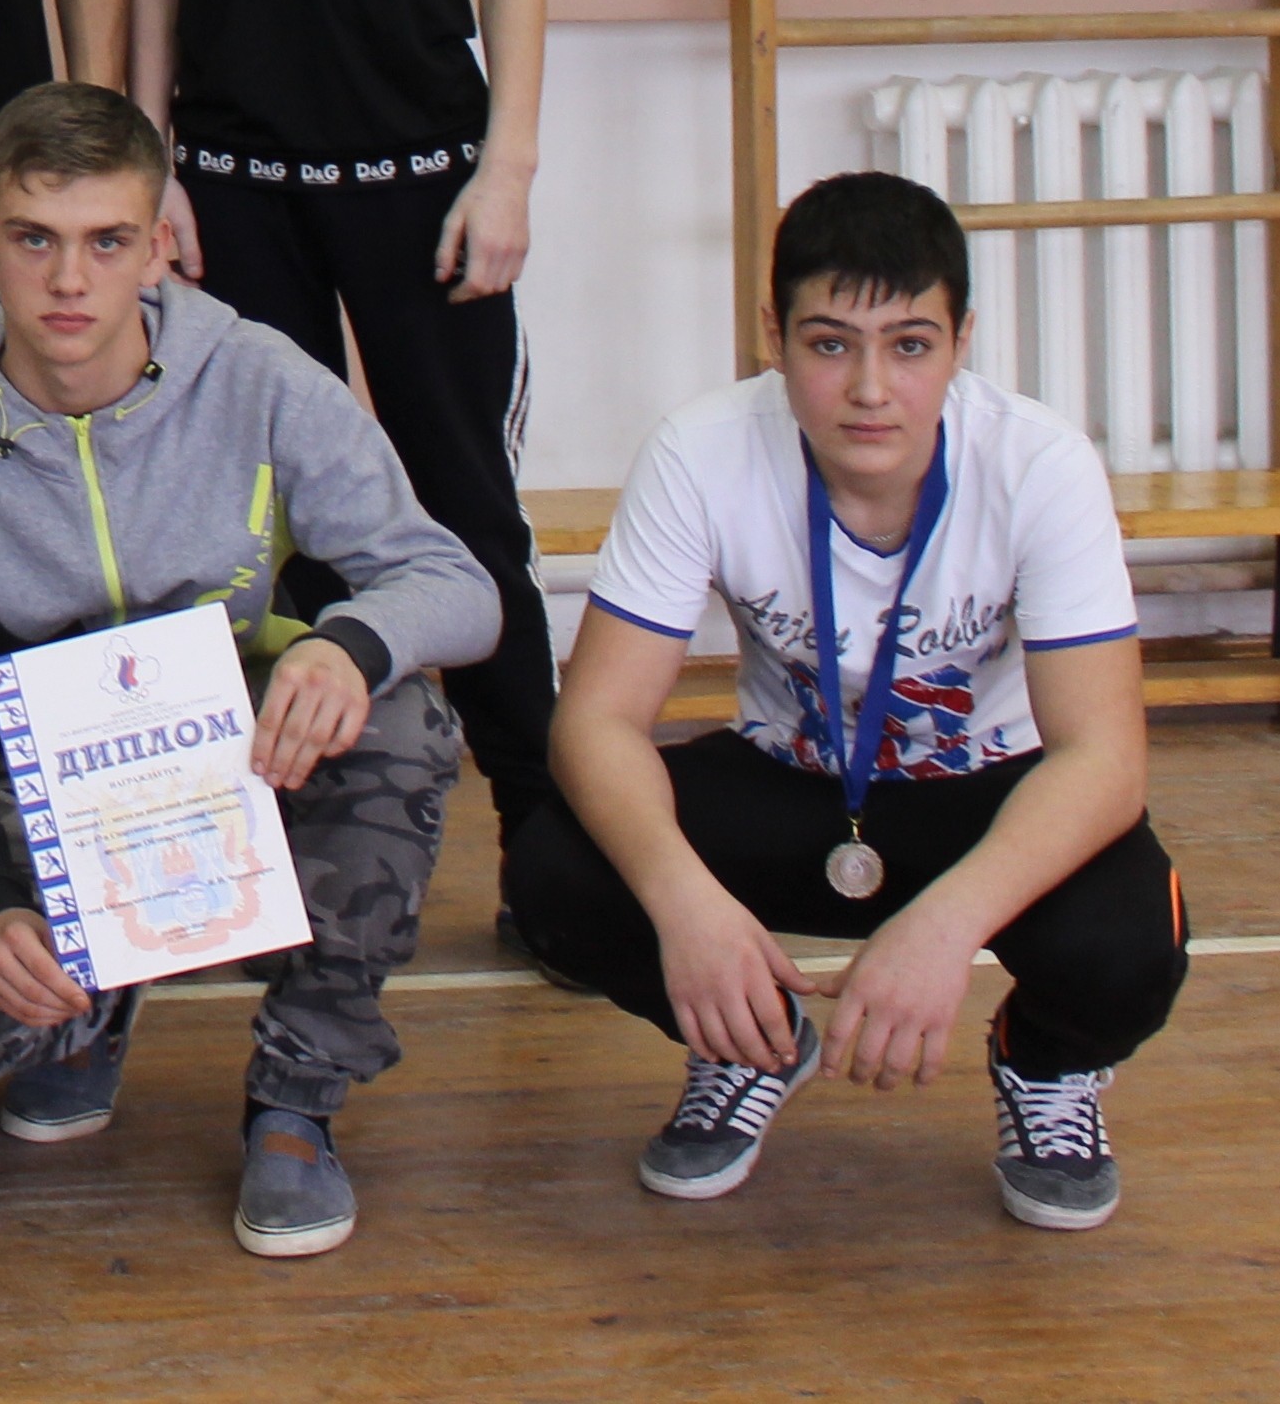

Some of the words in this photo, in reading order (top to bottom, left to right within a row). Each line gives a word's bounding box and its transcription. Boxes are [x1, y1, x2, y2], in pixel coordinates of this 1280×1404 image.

[198, 149, 236, 174] D&G
[248, 158, 287, 181] D&G
[300, 163, 341, 184] D&G
[355, 159, 397, 182] D&G
[410, 149, 451, 175] D&G
[53, 707, 244, 786] ДИПЛОМ
